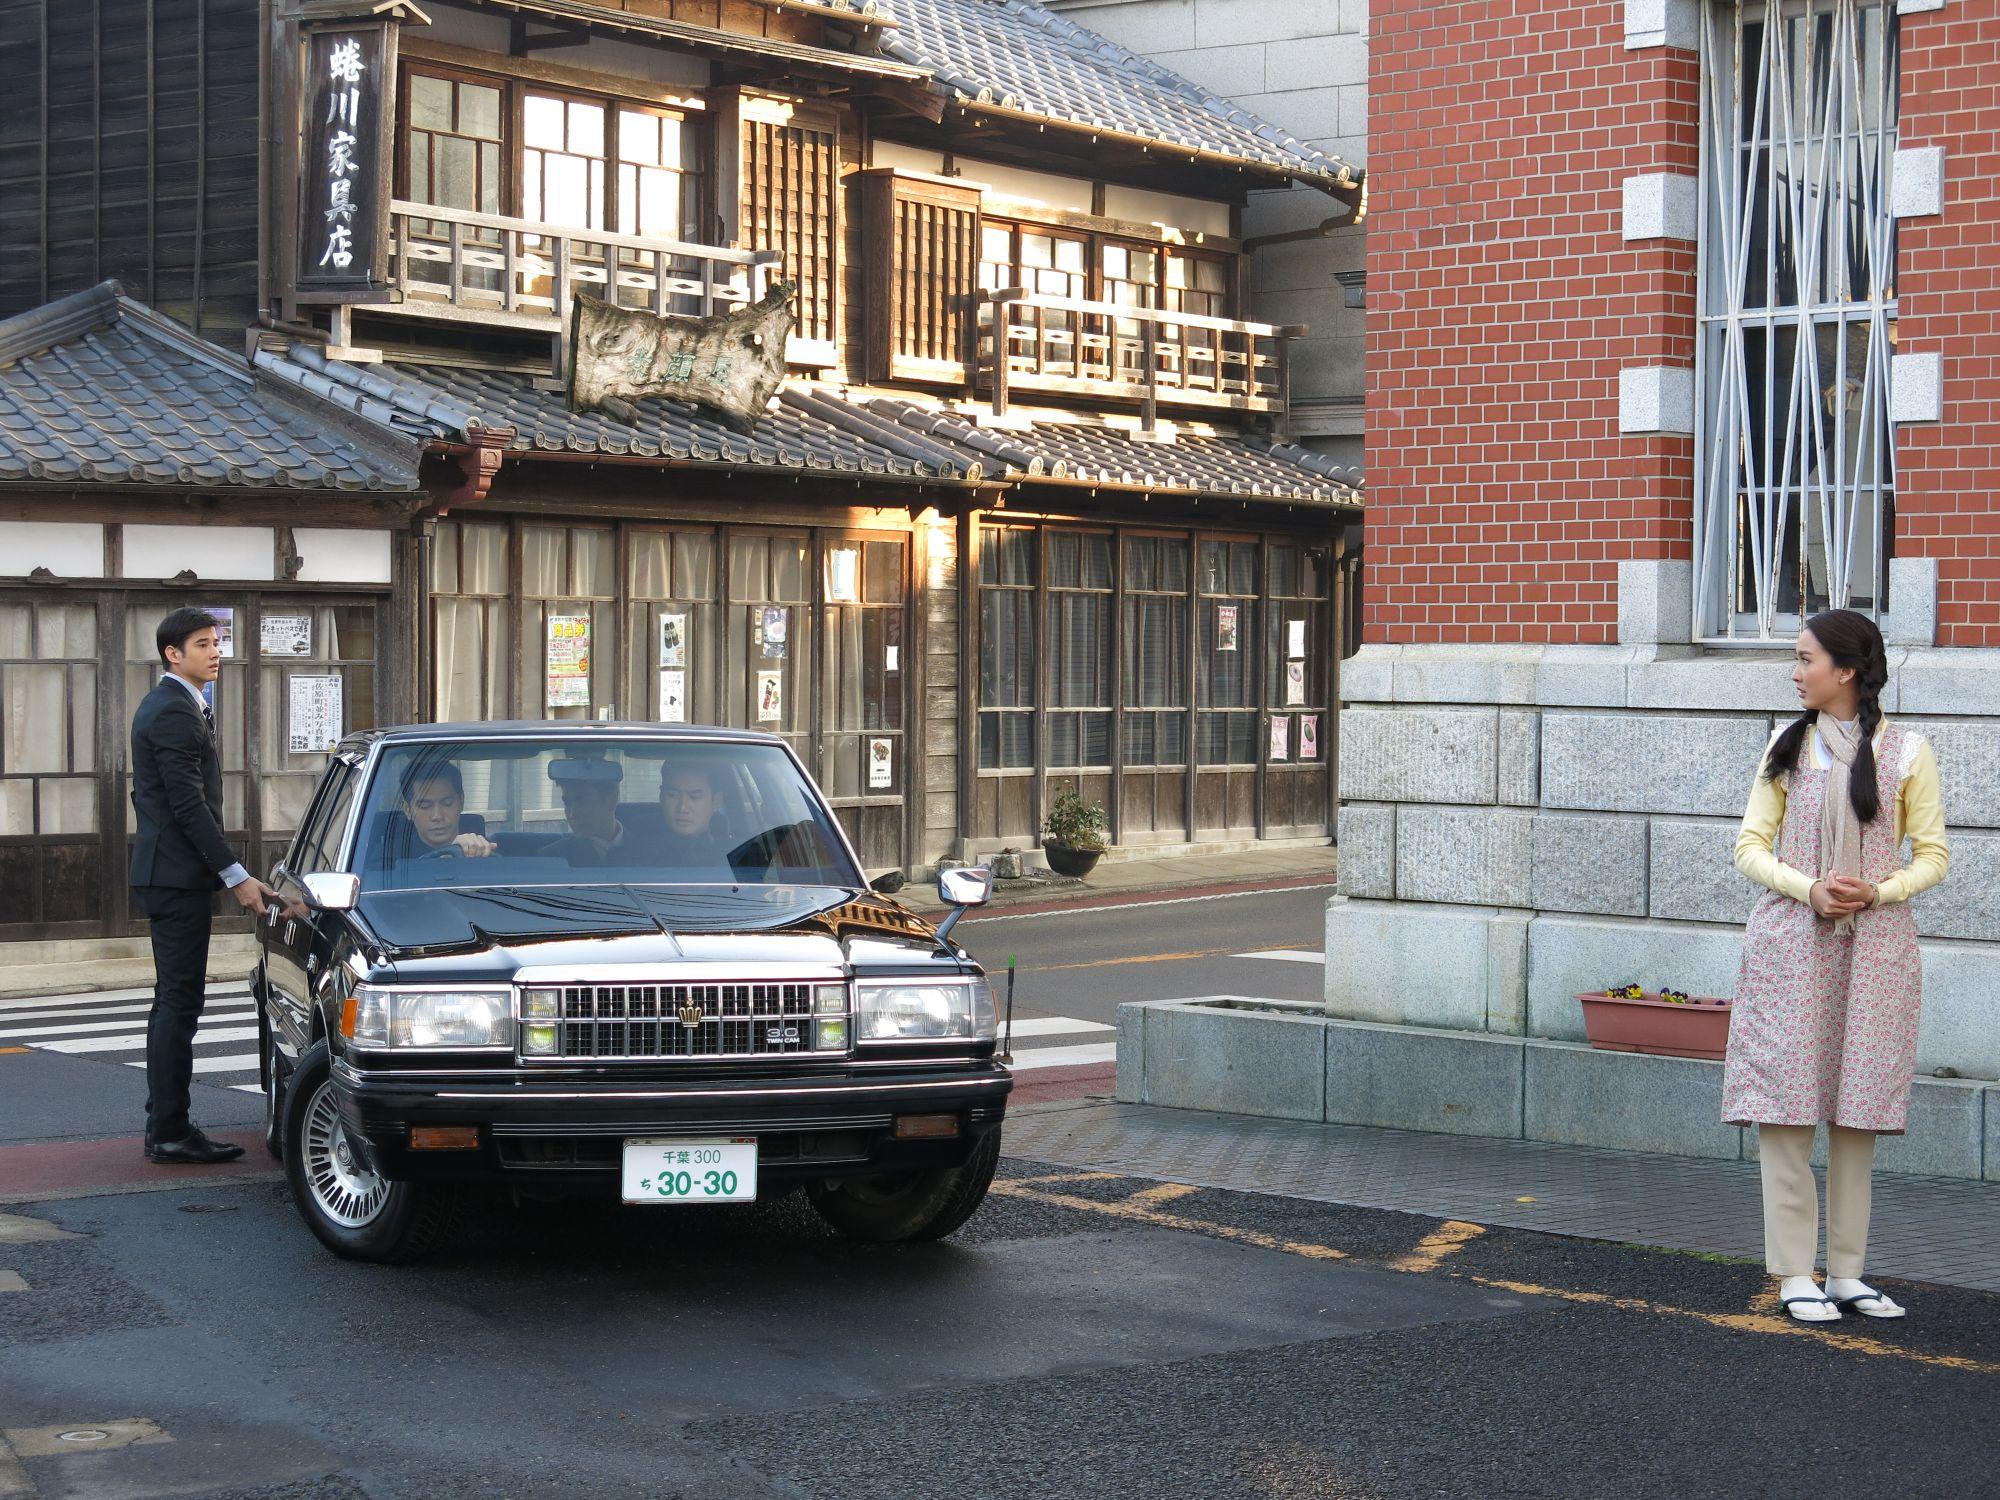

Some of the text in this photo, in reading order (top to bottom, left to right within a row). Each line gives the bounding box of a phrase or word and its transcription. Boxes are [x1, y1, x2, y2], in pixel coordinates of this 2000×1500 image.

[319, 37, 367, 268] 蜷川家具店
[553, 623, 585, 638] 商品券
[767, 1027, 799, 1038] 3.0
[663, 1150, 721, 1164] 千葉 300
[640, 1170, 738, 1196] ち 30-30
